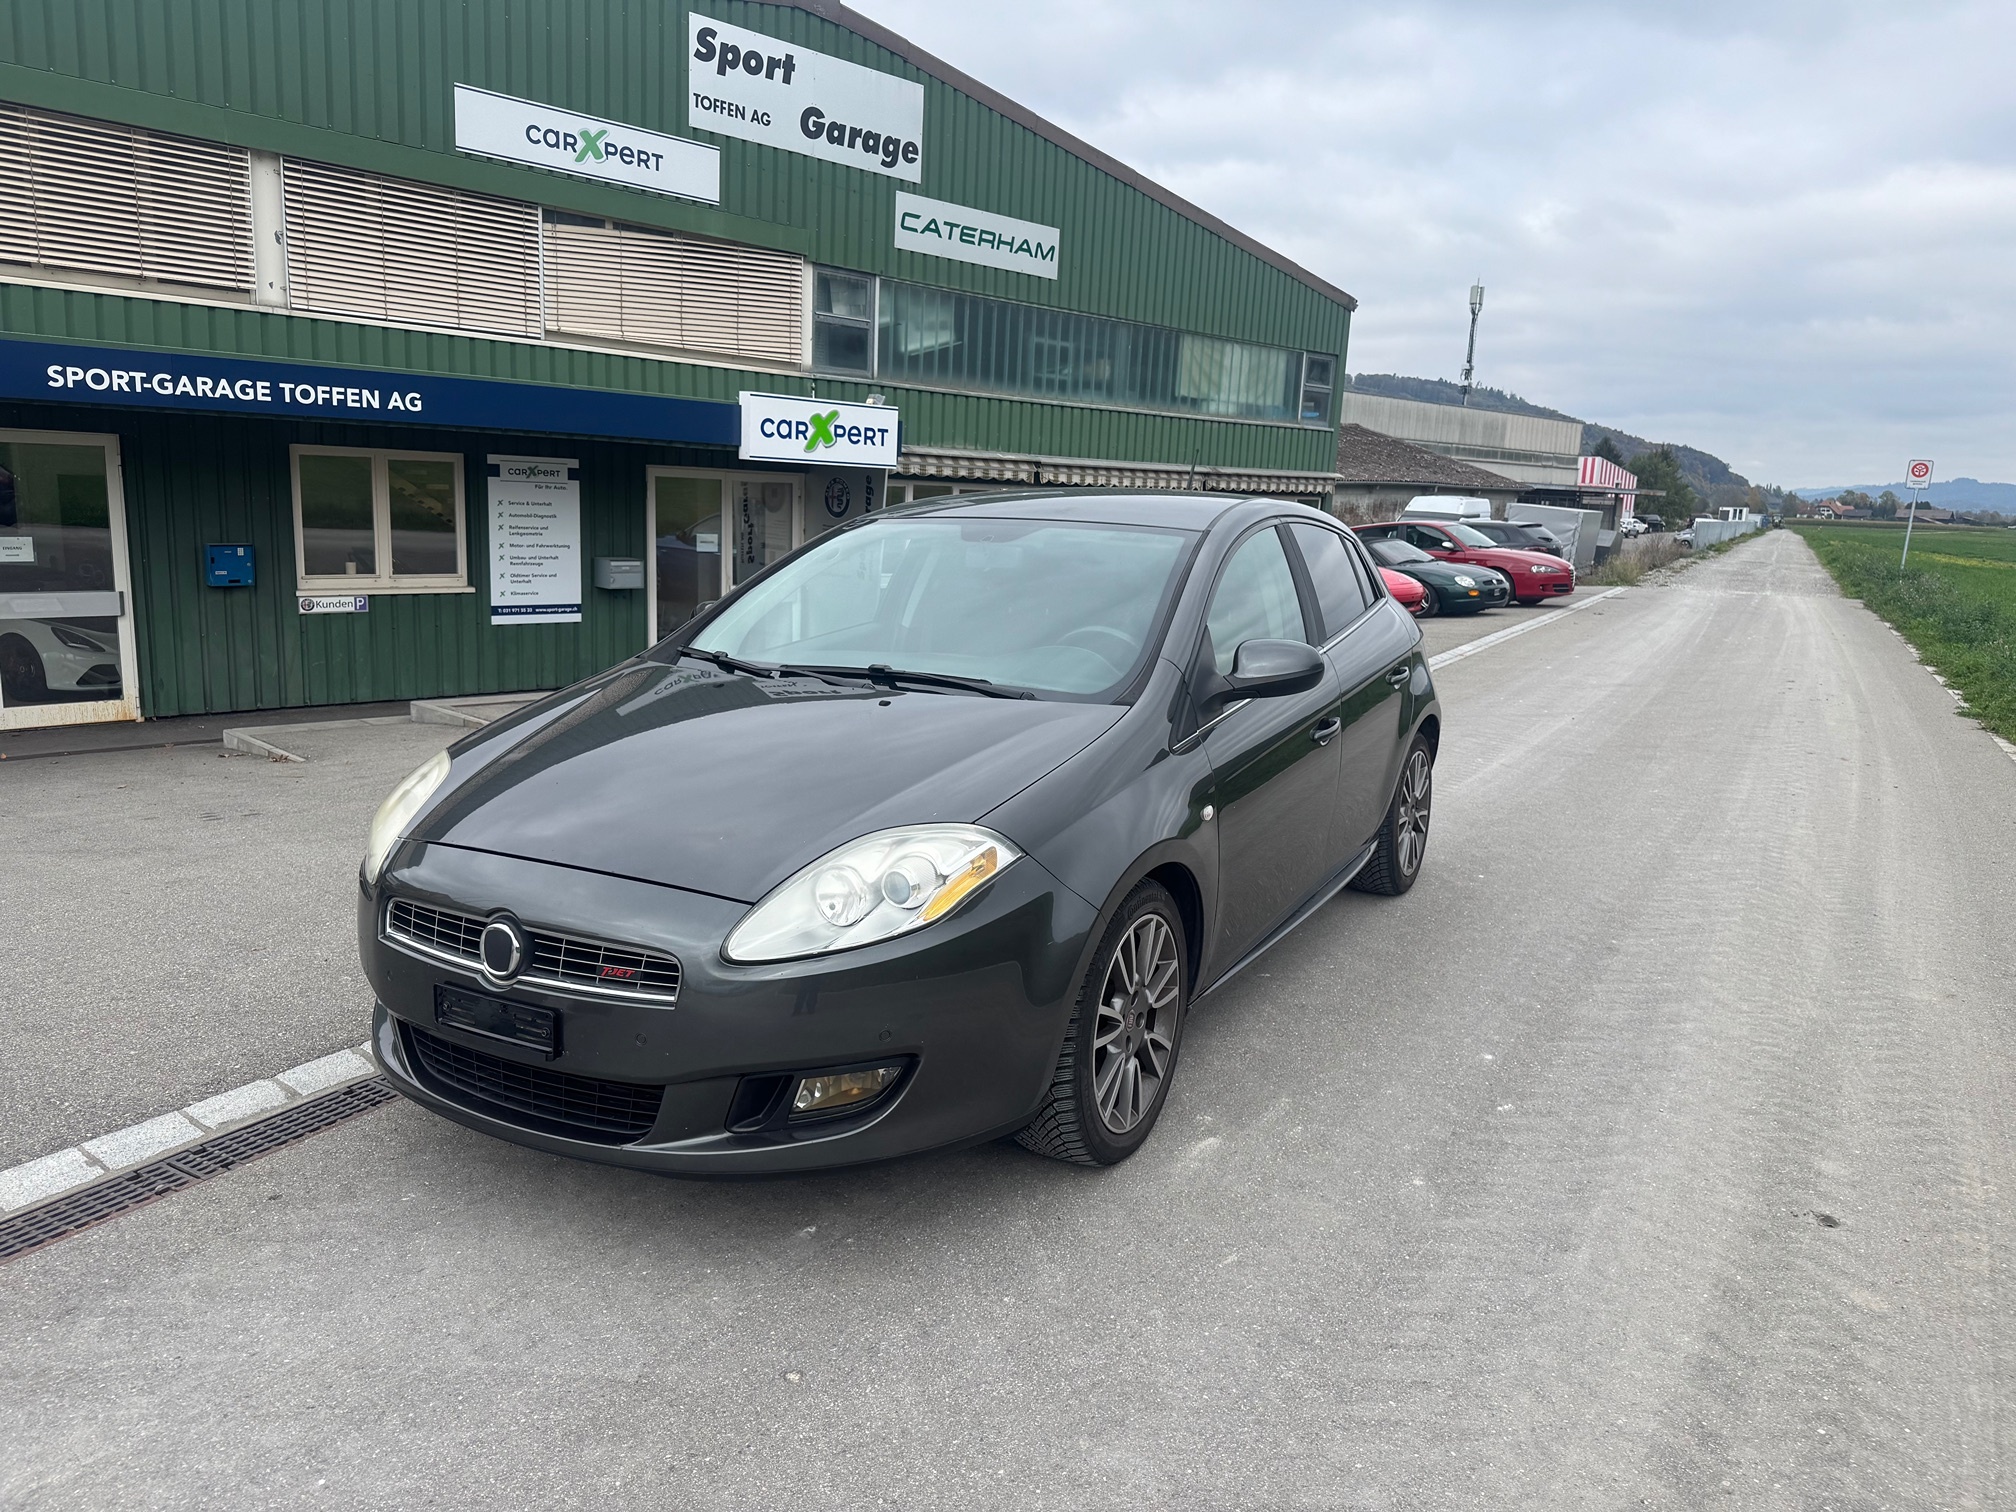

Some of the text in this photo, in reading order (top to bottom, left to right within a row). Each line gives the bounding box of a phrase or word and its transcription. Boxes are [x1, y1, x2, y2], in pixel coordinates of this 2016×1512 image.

[693, 27, 796, 85] Sport
[693, 92, 771, 127] TOFFEN AG
[800, 106, 919, 168] Garage
[900, 211, 1055, 262] CATERHAM
[46, 365, 423, 412] SPORT-GARAGE TOFFEN AG
[865, 475, 874, 513] rage
[315, 600, 353, 609] Kunden
[356, 597, 364, 610] P
[601, 966, 636, 978] T-JET
